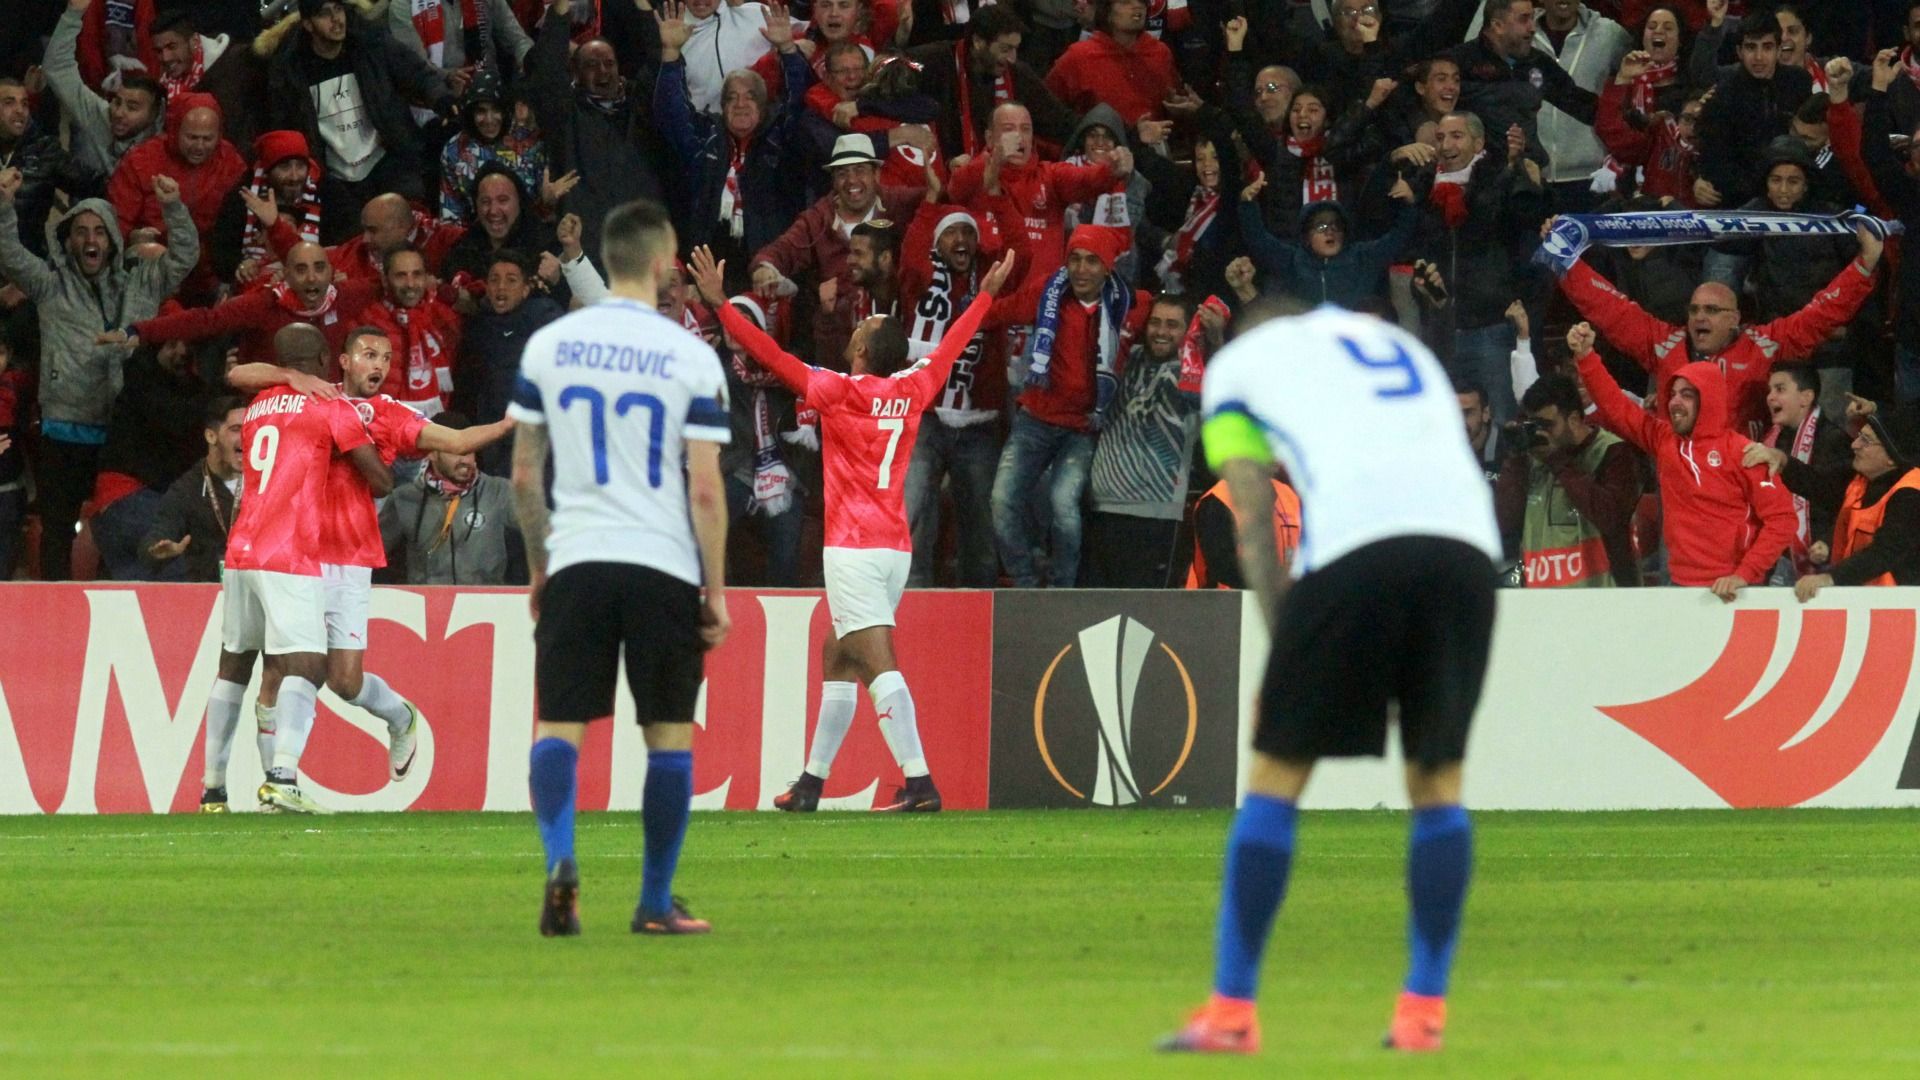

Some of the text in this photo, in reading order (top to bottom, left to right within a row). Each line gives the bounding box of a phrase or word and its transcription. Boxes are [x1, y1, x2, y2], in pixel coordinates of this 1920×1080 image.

[244, 394, 307, 424] NWAKAEME
[870, 397, 911, 417] RADI
[250, 424, 280, 495] 9
[559, 385, 665, 489] 77
[877, 418, 904, 489] 7
[1525, 552, 1582, 582] HOTO
